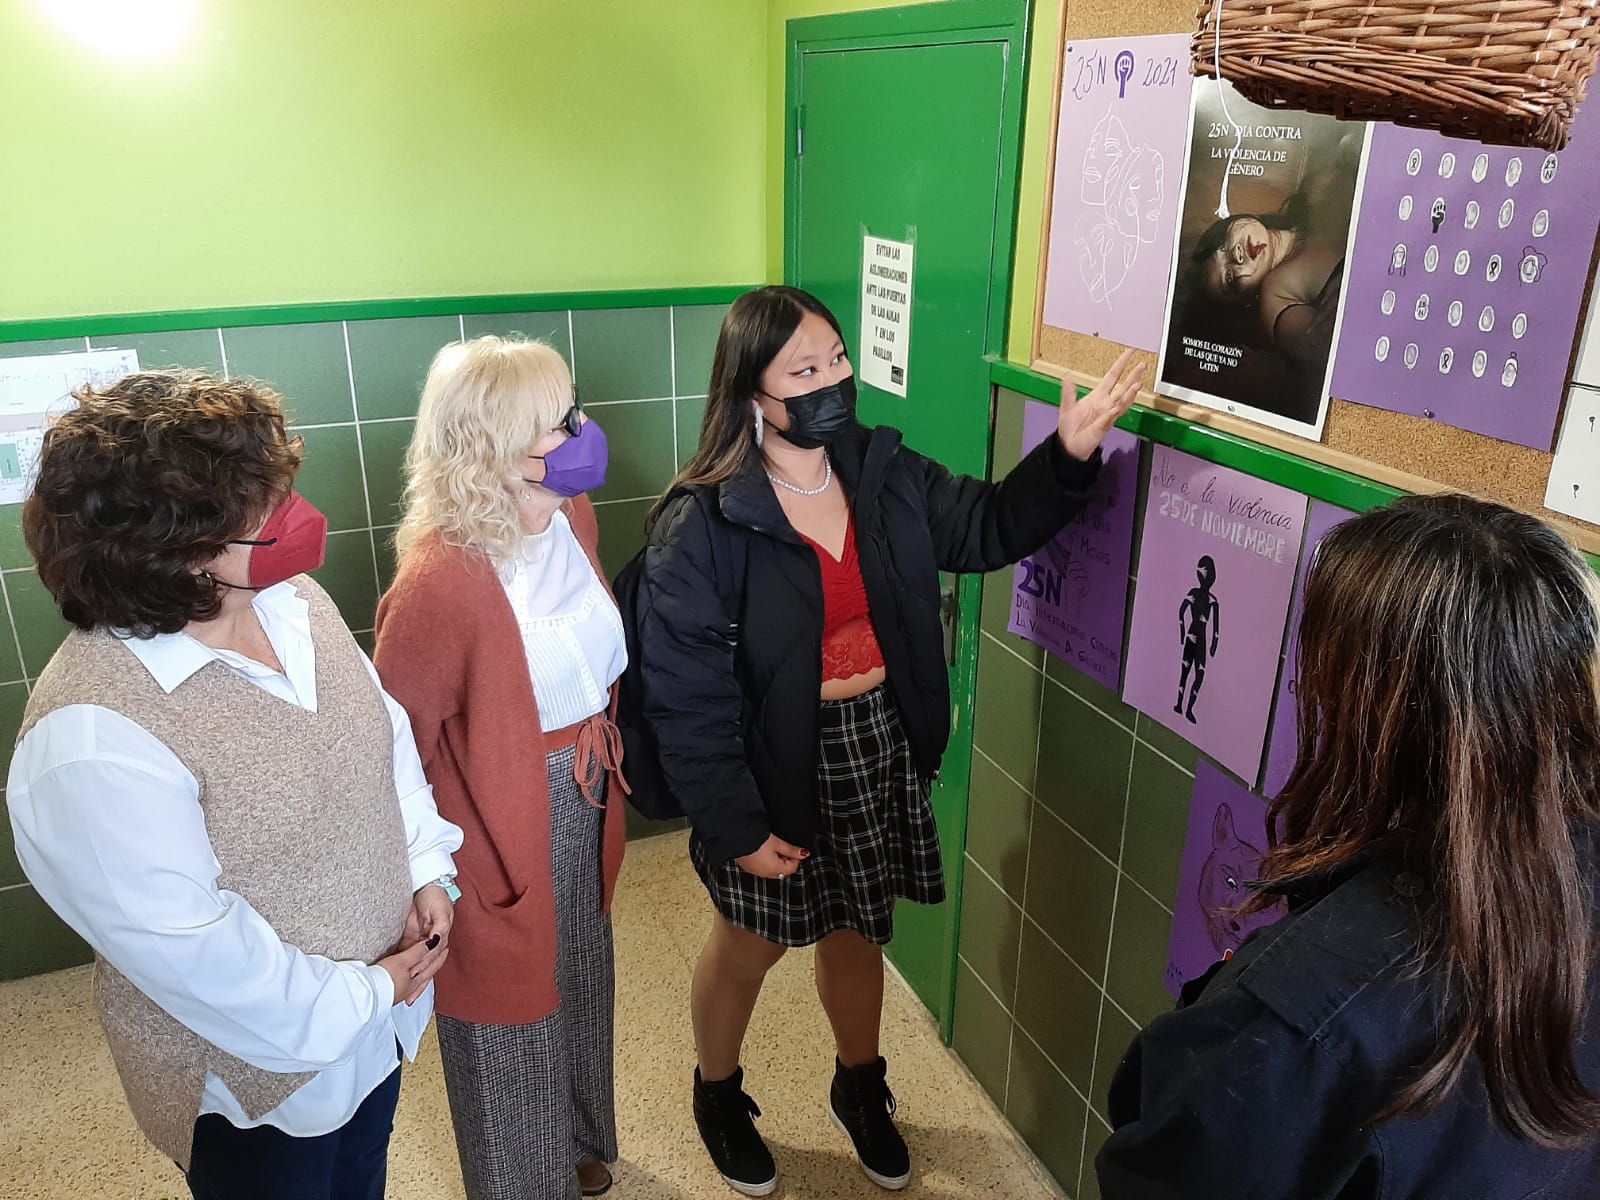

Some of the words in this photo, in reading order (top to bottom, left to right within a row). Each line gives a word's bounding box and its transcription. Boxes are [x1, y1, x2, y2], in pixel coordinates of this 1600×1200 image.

[1072, 49, 1107, 100] 25N
[1142, 57, 1178, 87] 2021
[1208, 122, 1229, 138] 25N
[1255, 126, 1302, 140] CONTRA
[1211, 147, 1222, 158] LA
[1224, 148, 1271, 161] VIOLENCIA
[1273, 151, 1287, 162] DE
[876, 244, 891, 258] EVITAR
[892, 247, 901, 260] LAS
[866, 282, 877, 296] ANTE
[878, 285, 886, 299] LAS
[887, 288, 907, 305] PUERTAS
[871, 304, 877, 316] DE
[877, 306, 885, 318] LAS
[886, 308, 900, 324] AULAS
[875, 325, 879, 337] Y
[879, 327, 886, 340] EN
[886, 329, 895, 343] LOS
[872, 344, 893, 363] PASILLOS
[1182, 336, 1203, 349] SOMOS
[1203, 341, 1211, 350] EL
[1211, 343, 1243, 358] CORAZÓN
[1184, 347, 1194, 356] DE
[1193, 349, 1205, 359] LAS
[1205, 352, 1218, 362] QUE
[1219, 355, 1227, 365] YA
[1227, 358, 1238, 367] NO
[1199, 361, 1220, 373] LATEN
[1200, 476, 1216, 504] la
[1201, 509, 1287, 565] NOVIEMBRE
[1018, 560, 1062, 607] 25N
